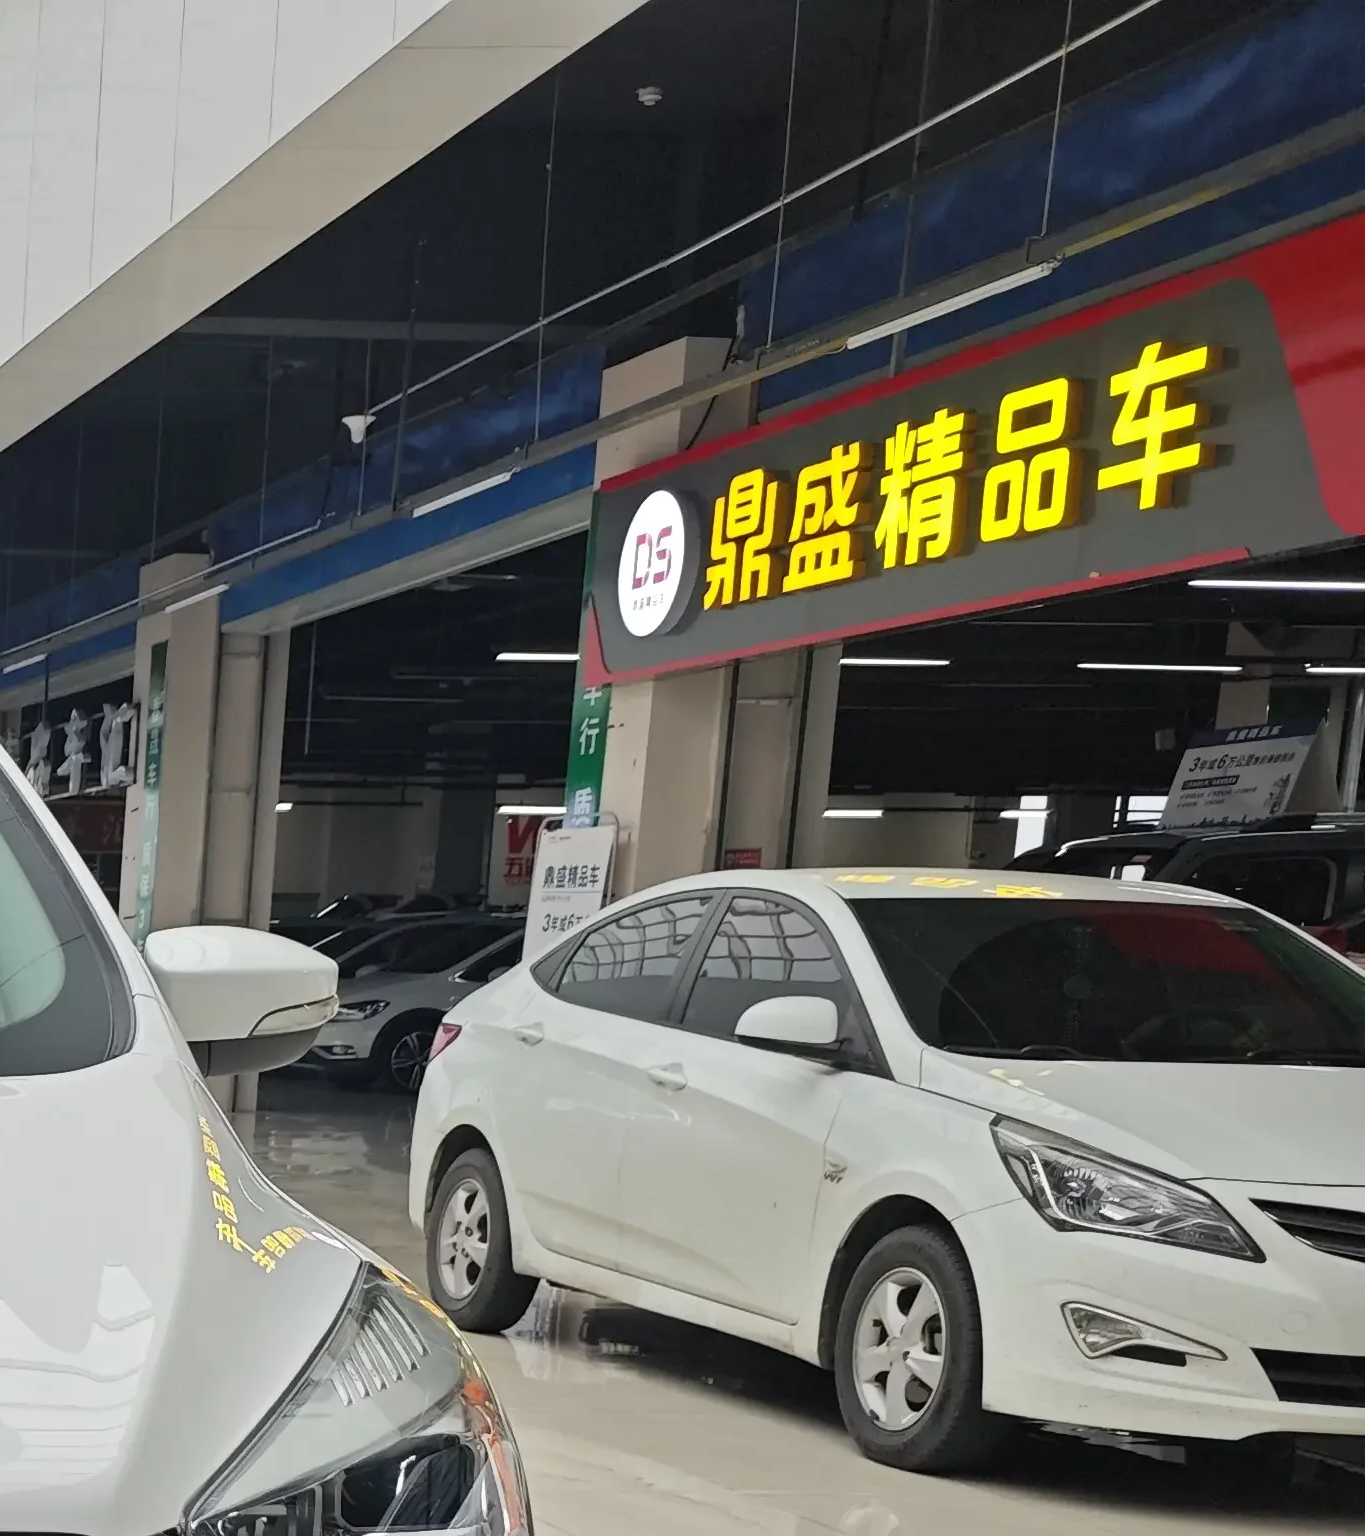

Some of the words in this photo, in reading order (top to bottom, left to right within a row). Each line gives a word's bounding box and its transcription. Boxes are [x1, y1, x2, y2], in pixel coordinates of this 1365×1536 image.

[632, 525, 673, 590] DS
[703, 341, 1215, 610] 鼎盛精品车
